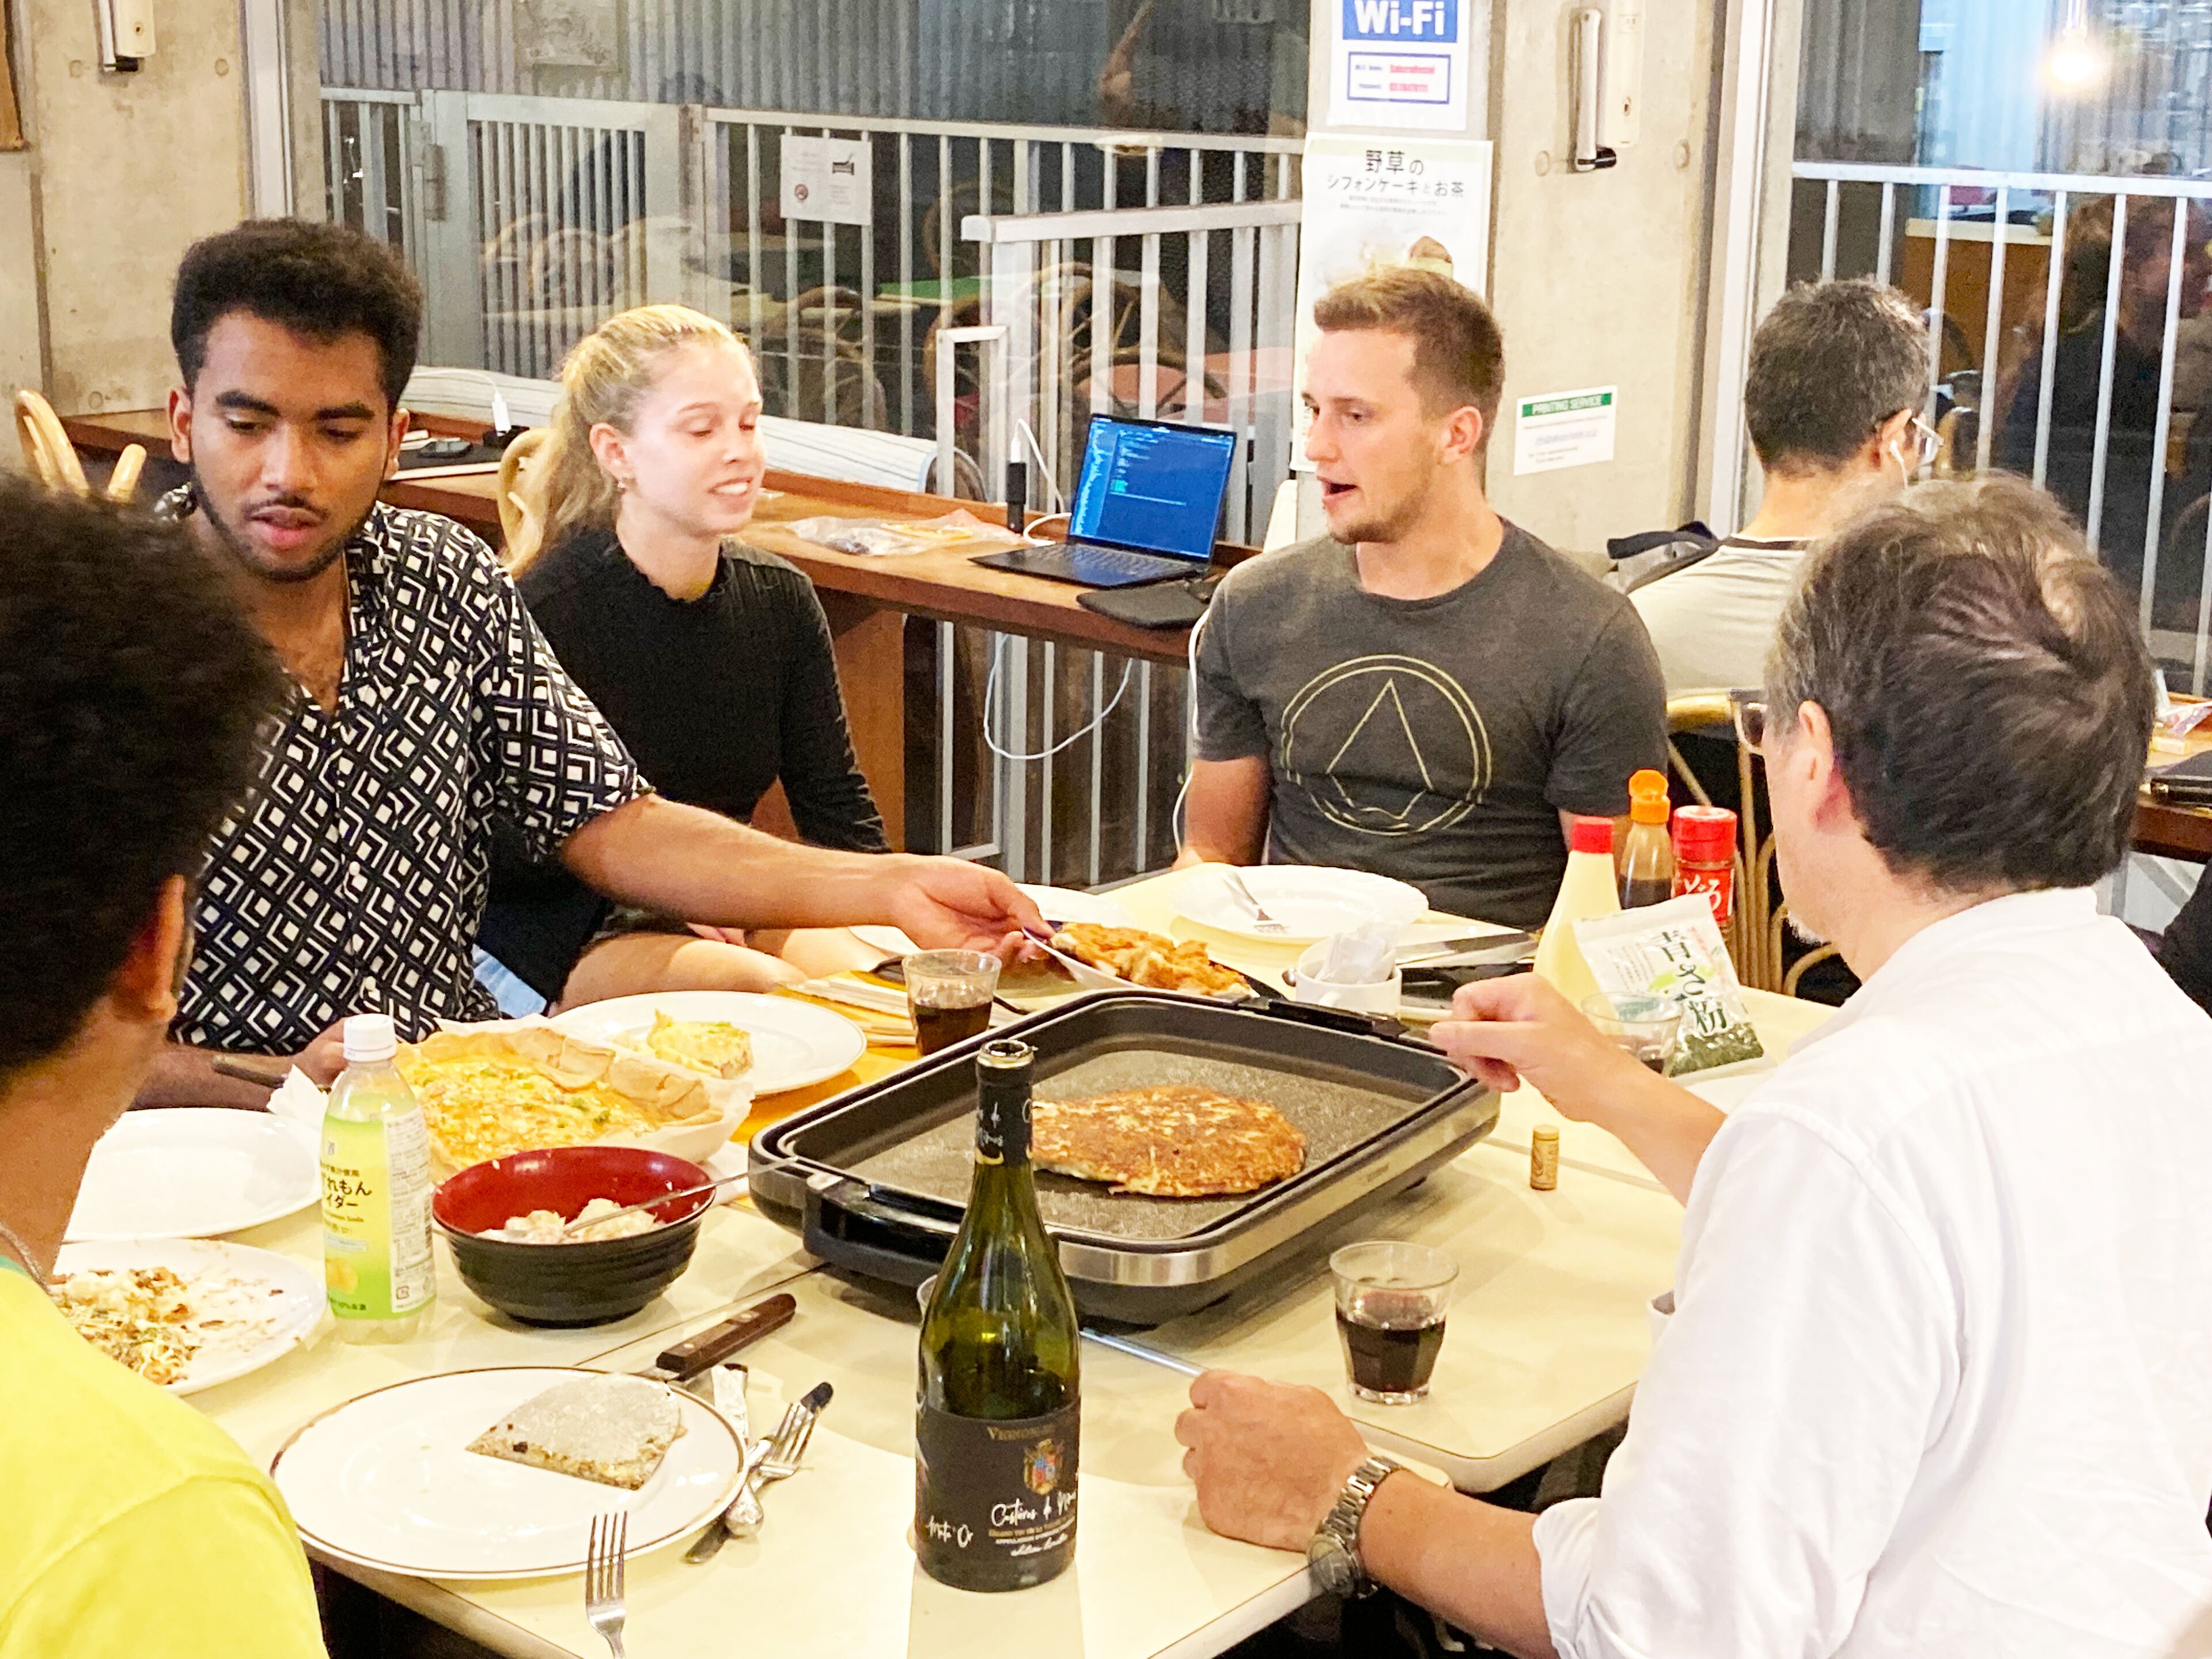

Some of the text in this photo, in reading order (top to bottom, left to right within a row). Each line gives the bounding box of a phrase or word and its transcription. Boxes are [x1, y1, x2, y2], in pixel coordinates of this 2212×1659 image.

[1354, 0, 1445, 35] Wi-Fi
[1365, 150, 1425, 176] 野草の
[1327, 175, 1464, 198] シフォンケーキとお茶
[322, 1172, 372, 1196] れもん
